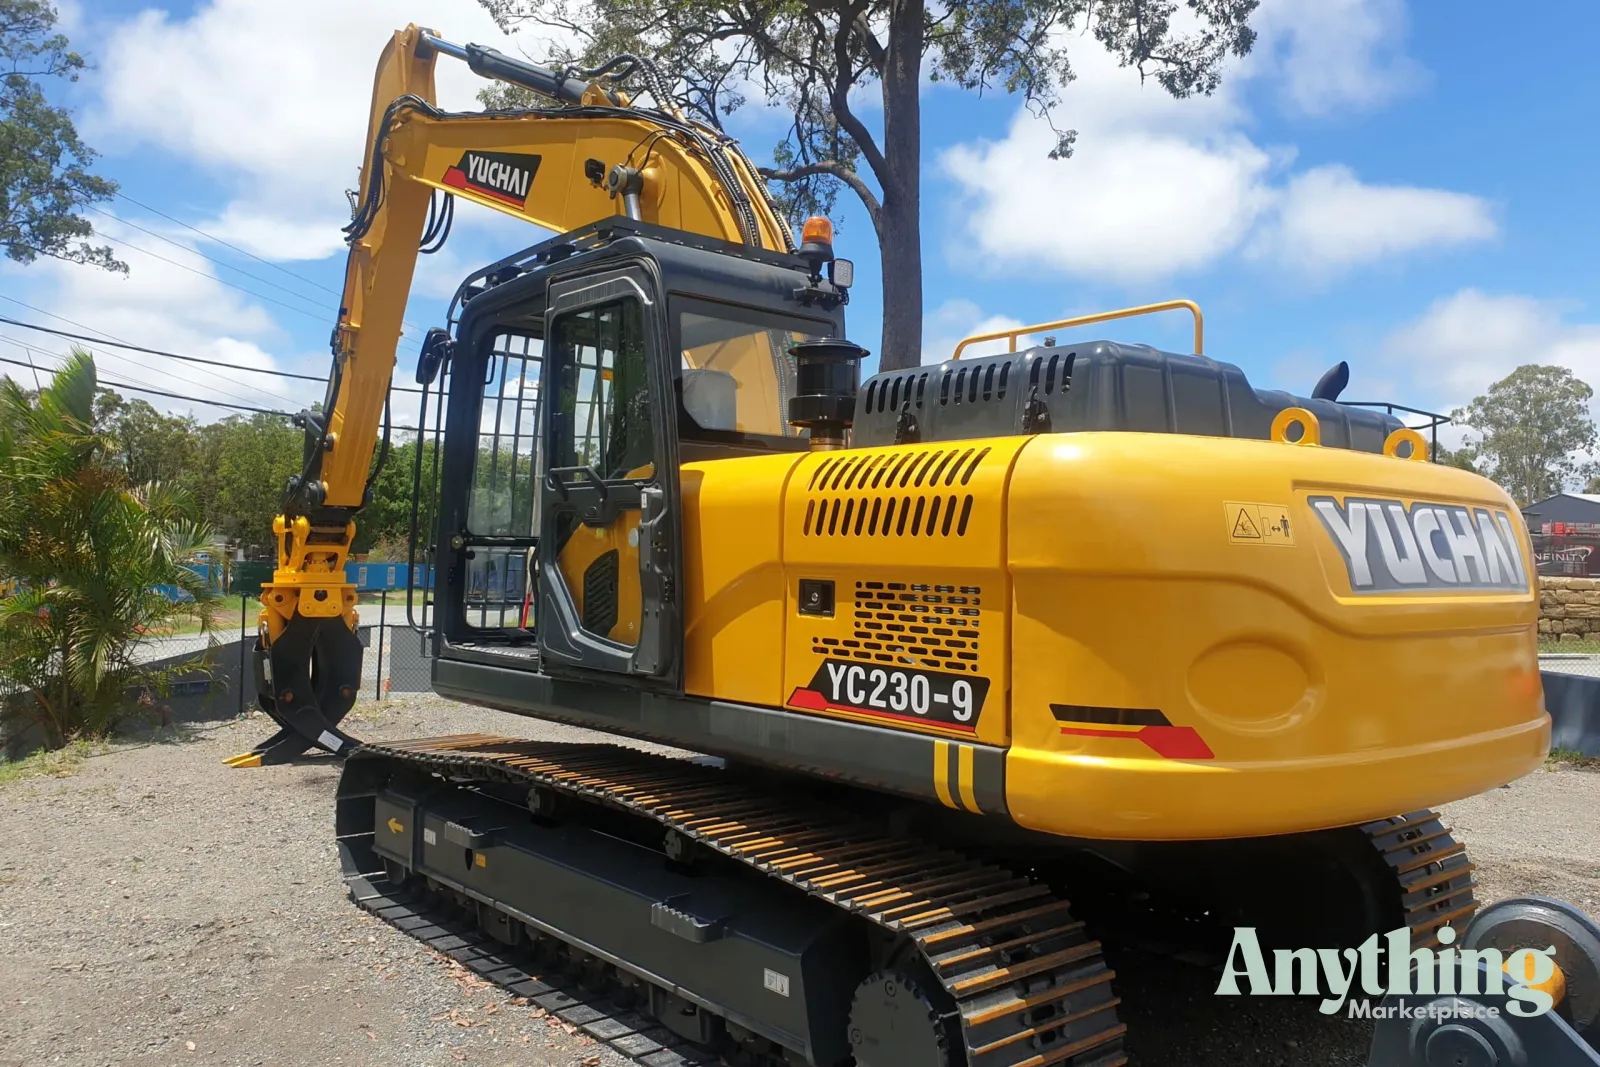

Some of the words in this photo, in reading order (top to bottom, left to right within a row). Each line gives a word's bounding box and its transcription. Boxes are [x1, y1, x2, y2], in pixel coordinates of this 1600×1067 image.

[468, 153, 530, 197] YUCHAI
[1313, 500, 1527, 588] YUCHAI
[1534, 552, 1587, 562] NFINITY
[826, 662, 974, 722] YC230-9
